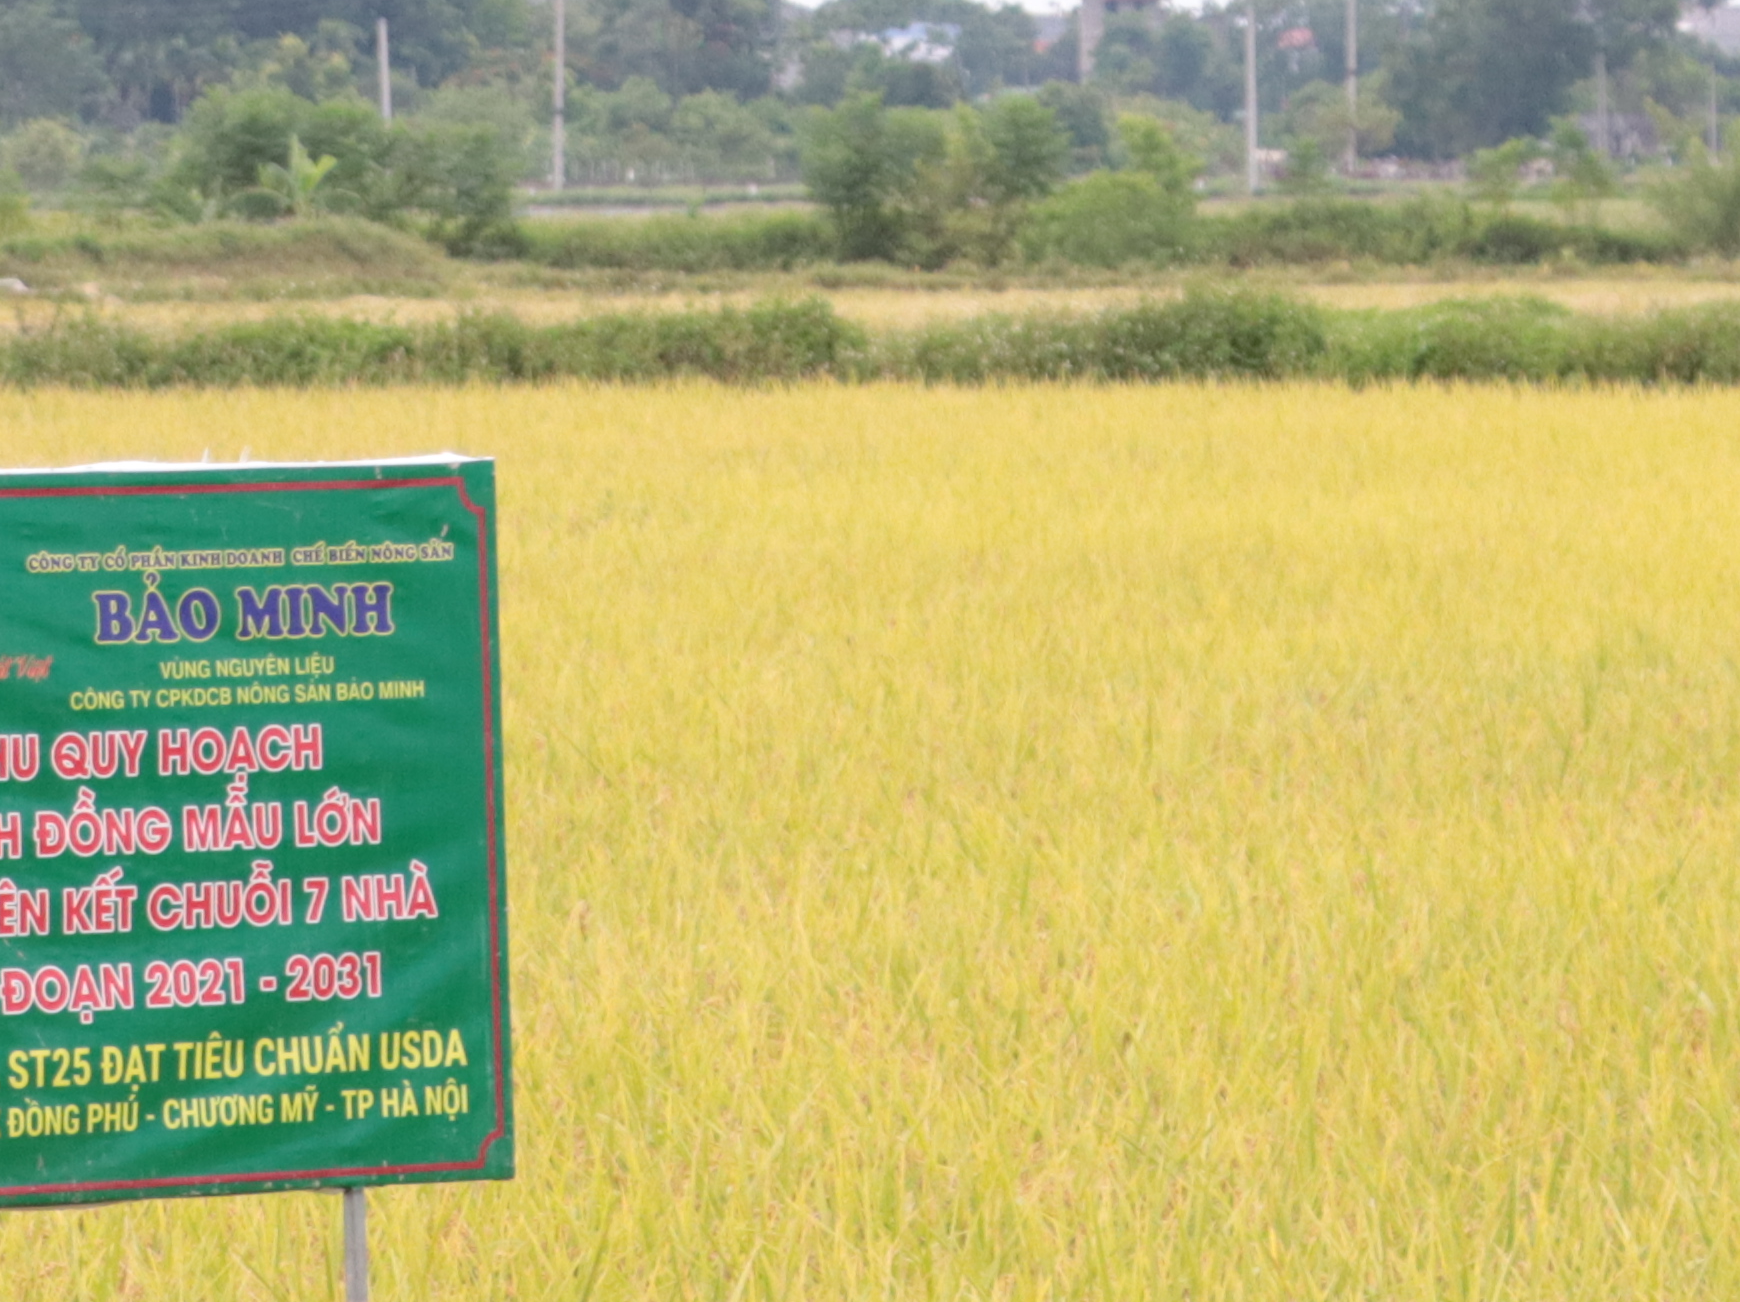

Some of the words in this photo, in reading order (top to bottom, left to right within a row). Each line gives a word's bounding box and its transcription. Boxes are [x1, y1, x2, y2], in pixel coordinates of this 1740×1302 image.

[27, 551, 73, 572] CÔNG
[76, 552, 100, 571] TY
[179, 550, 222, 568] KINH
[225, 548, 285, 568] DOANH
[291, 540, 325, 565] CHẾ
[327, 540, 367, 564] BIẾN
[370, 540, 417, 563] NÔNG
[92, 569, 220, 645] BẢO
[234, 581, 395, 641] MINH
[71, 686, 124, 710] CÔNG
[129, 689, 151, 708] TY
[155, 687, 233, 707] CPKDCB
[237, 681, 290, 704] NÔNG
[378, 680, 425, 699] MINH
[160, 655, 211, 679] VÙNG
[216, 653, 290, 678] NGUYÊN
[295, 653, 335, 680] LIỆU
[50, 729, 147, 779] QUY
[158, 724, 322, 785] HOẠCH
[34, 785, 171, 857] ĐỒNG
[182, 782, 282, 853] MẪU
[294, 786, 381, 847] LỚN
[62, 866, 137, 935] KẾT
[146, 860, 293, 930] CHUỖI
[302, 878, 329, 923] 7
[341, 859, 438, 922] NHÀ
[145, 958, 245, 1008] 2021
[259, 975, 277, 991] -
[285, 951, 382, 1002] 2031
[8, 1046, 92, 1090] ST25
[100, 1043, 166, 1092] ĐẠT
[173, 1031, 244, 1080] TIÊU
[253, 1021, 370, 1077] CHUẨN
[379, 1028, 468, 1070] USDA
[7, 1097, 80, 1137] ĐỒNG
[86, 1093, 139, 1133] PHÚ
[145, 1112, 155, 1121] -
[163, 1093, 274, 1130] CHƯƠNG
[281, 1084, 319, 1123] MỸ
[325, 1104, 335, 1112] -
[341, 1089, 375, 1120] TP
[381, 1079, 418, 1118] HÀ
[424, 1077, 468, 1122] NỘI
